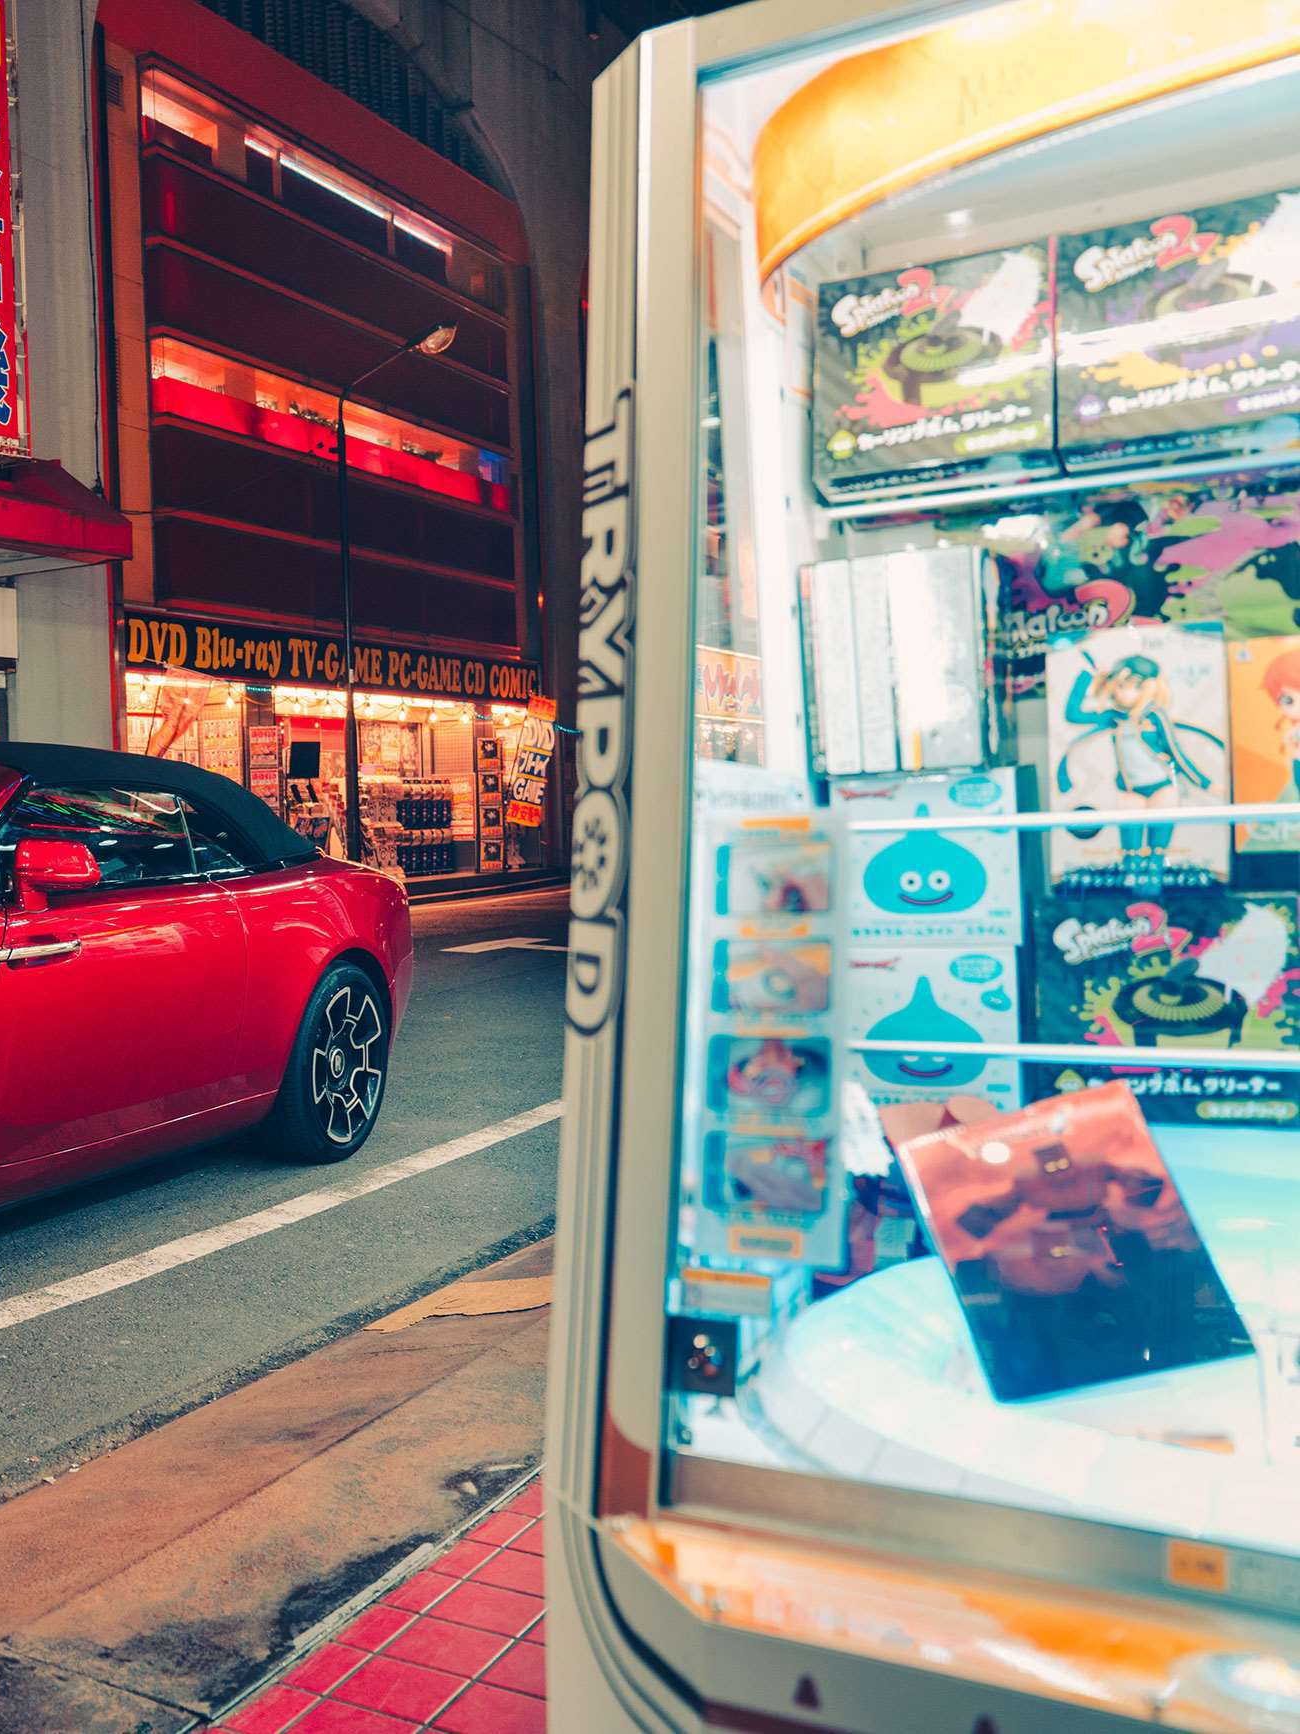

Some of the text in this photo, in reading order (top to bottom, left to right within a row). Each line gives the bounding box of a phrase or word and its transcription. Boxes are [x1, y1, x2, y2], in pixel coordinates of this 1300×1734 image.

[127, 618, 188, 666] DVD
[195, 626, 282, 679] Blu-ray
[387, 650, 462, 692] PC-GAME
[464, 661, 485, 695] CD
[489, 665, 537, 700] COMIC
